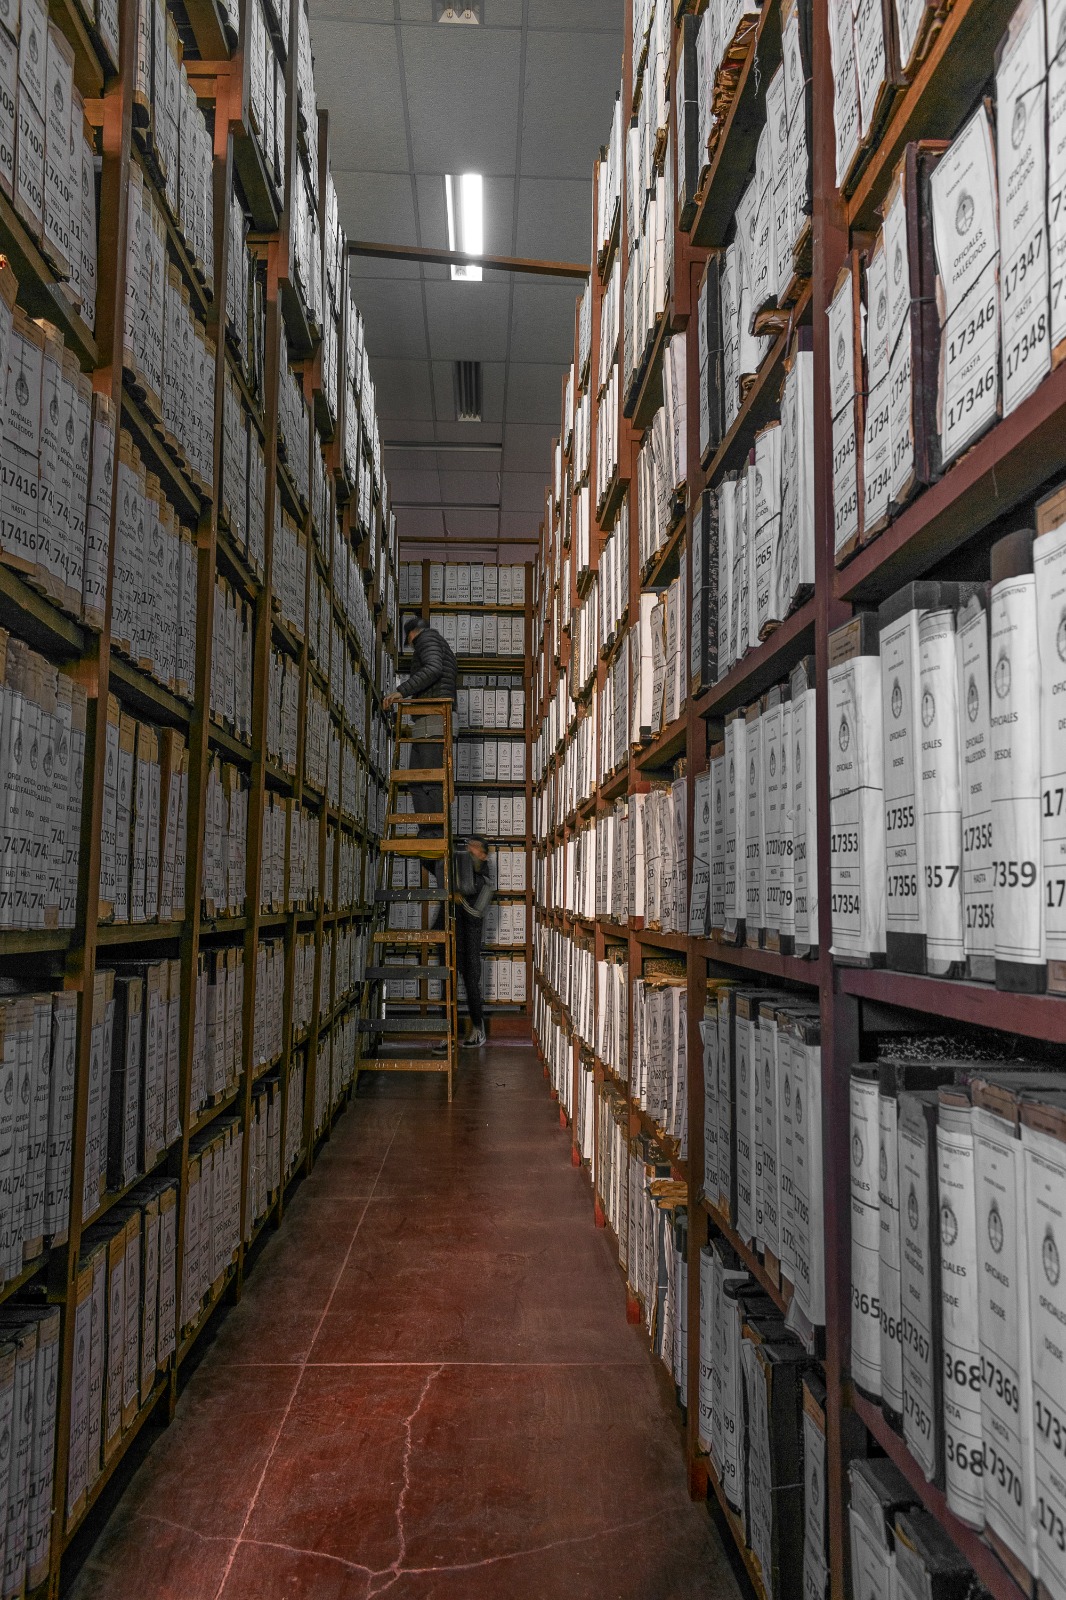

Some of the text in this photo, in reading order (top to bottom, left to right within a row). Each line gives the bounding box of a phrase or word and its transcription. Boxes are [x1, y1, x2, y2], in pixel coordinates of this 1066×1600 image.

[0, 91, 14, 119] 08
[20, 114, 44, 160] 17409
[0, 146, 13, 172] 08
[18, 166, 42, 209] 17409
[45, 160, 69, 203] 17410
[43, 209, 69, 248] 17410
[954, 228, 983, 268] OFICIALES
[952, 239, 987, 284] FALLECIDOS
[1005, 228, 1043, 301] 17347
[949, 297, 995, 365] 17346
[1006, 314, 1046, 381] 17348
[960, 355, 981, 380] HASTA
[11, 408, 32, 427] OFICIALES
[948, 366, 994, 431] 17346
[8, 418, 34, 439] FALLECIDOS
[868, 404, 889, 445] 1734
[834, 433, 855, 474] 17343
[893, 429, 912, 472] 1734
[2, 466, 37, 499] 17416
[11, 504, 26, 517] HASTA
[836, 491, 857, 531] 17343
[1, 520, 36, 550] 17416
[887, 805, 915, 831] 17355
[831, 833, 859, 853] 17353
[888, 875, 917, 897] 17356
[924, 865, 959, 888] 357
[832, 894, 860, 914] 17354
[903, 1317, 930, 1364] 17367
[980, 1356, 1020, 1414] 17369
[904, 1390, 931, 1440] 17367
[982, 1441, 1022, 1507] 17370
